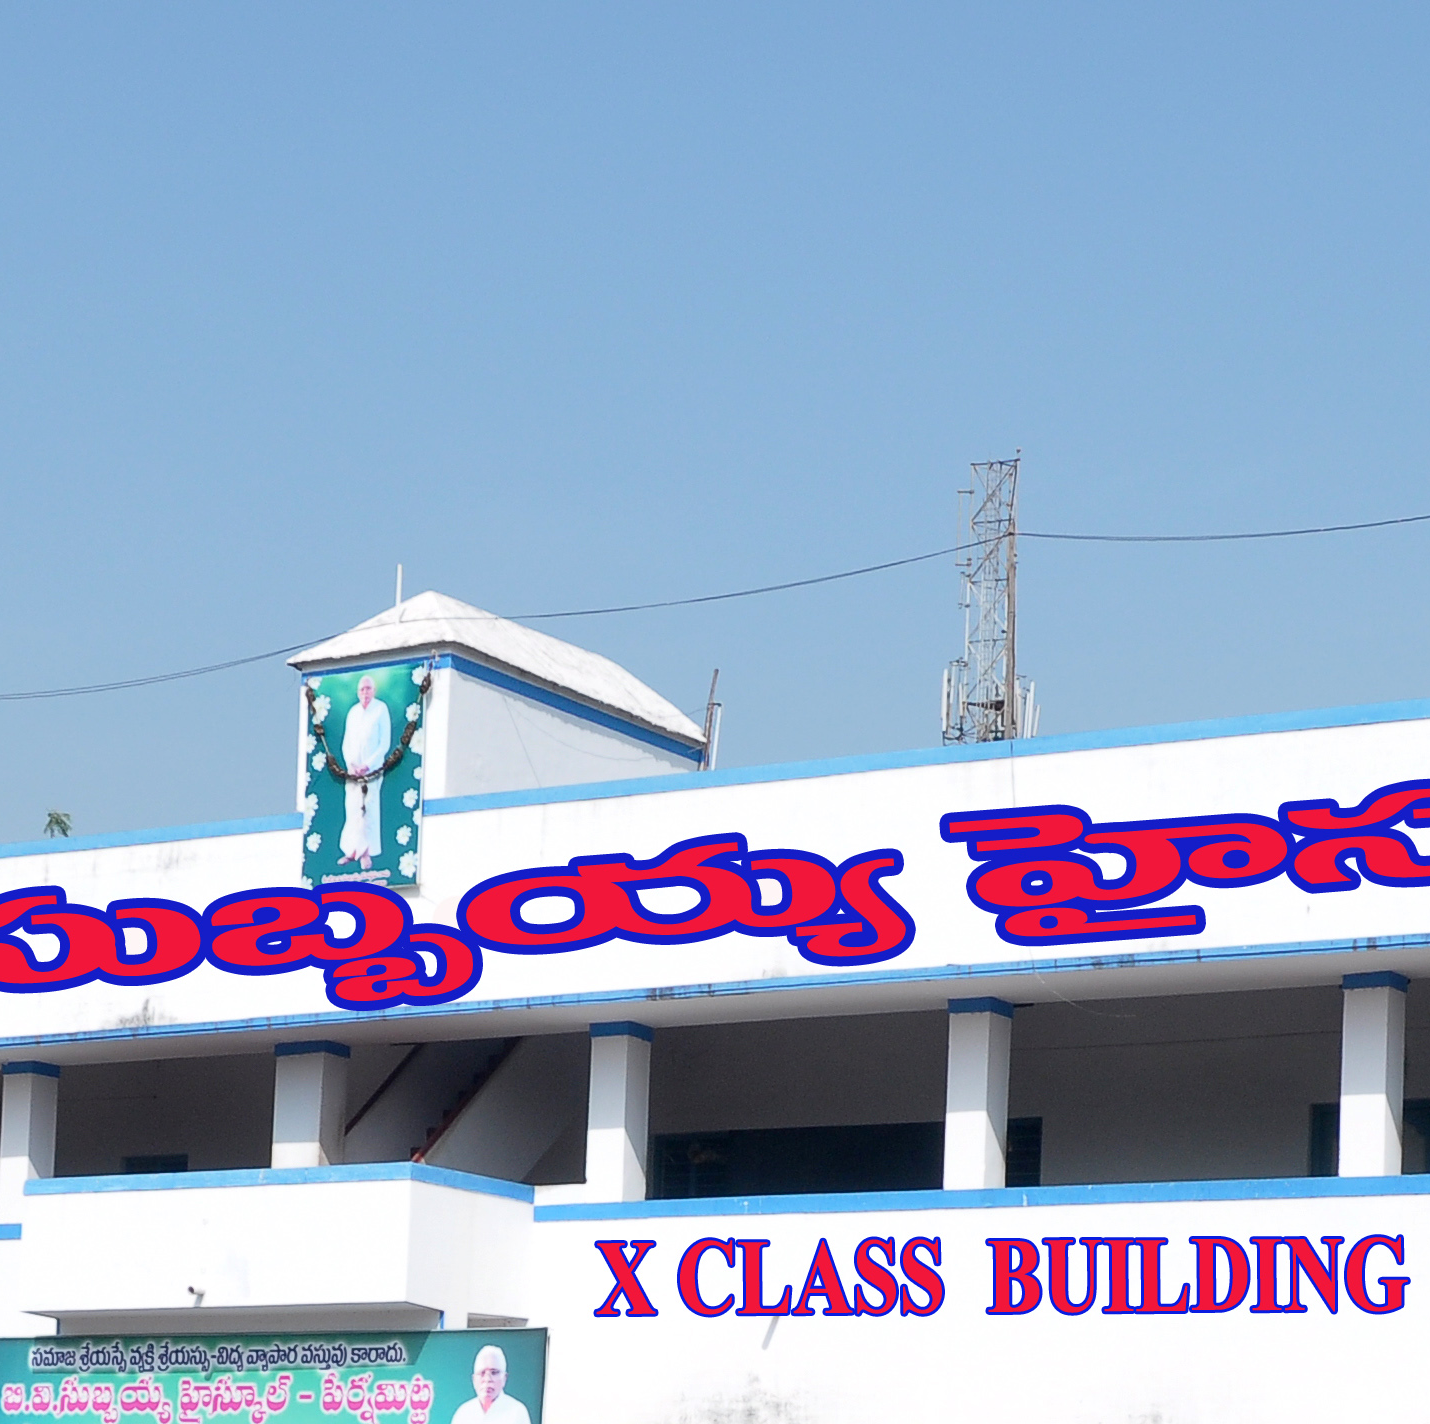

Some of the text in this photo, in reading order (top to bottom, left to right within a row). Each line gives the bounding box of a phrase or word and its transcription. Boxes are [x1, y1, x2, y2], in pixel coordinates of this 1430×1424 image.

[32, 1347, 76, 1366] సమాజ
[130, 1343, 155, 1372] వ్యక్తి
[247, 1343, 298, 1371] వ్యాపార
[301, 1343, 347, 1370] వస్తువు
[350, 1342, 407, 1364] కారాదు.
[179, 1374, 292, 1424] హైస్కూల్
